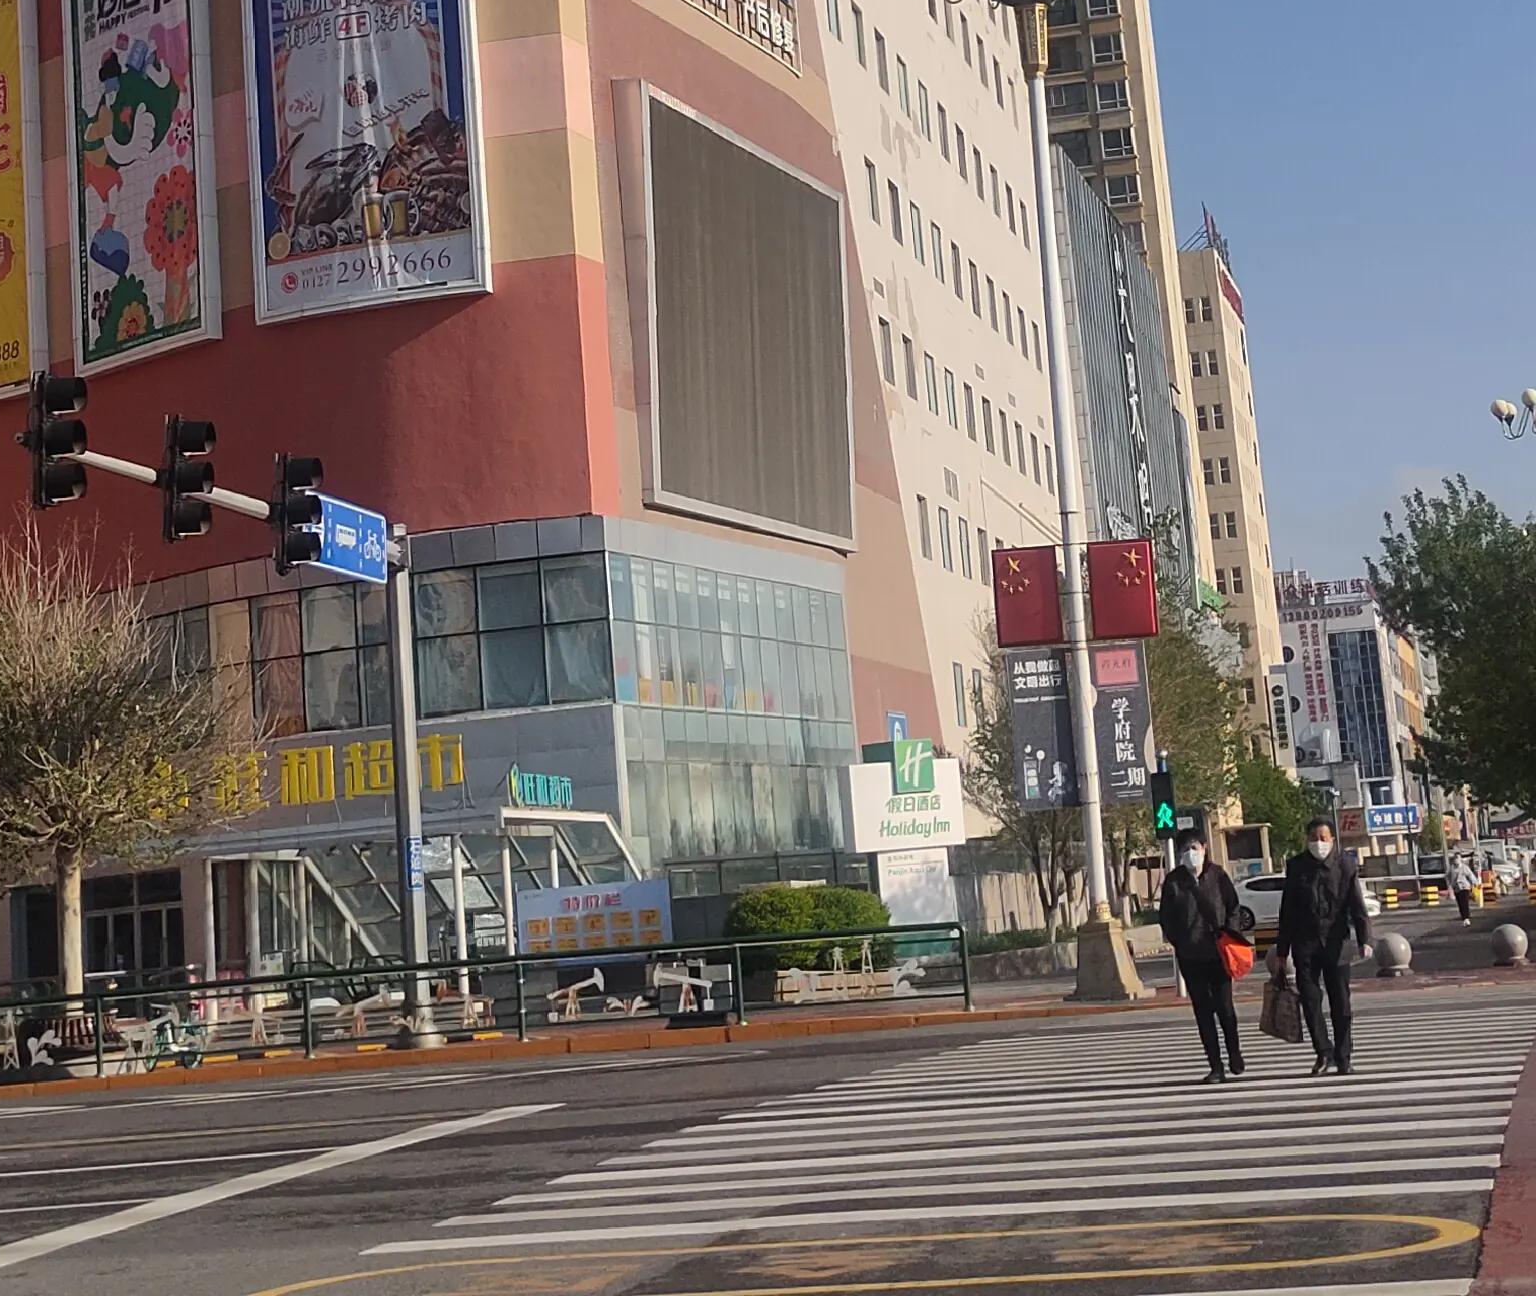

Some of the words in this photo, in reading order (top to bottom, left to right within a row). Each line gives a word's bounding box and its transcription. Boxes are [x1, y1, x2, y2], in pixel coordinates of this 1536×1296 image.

[99, 12, 127, 35] HAPPY
[338, 16, 368, 36] 4F
[336, 247, 452, 284] 2992666
[1013, 674, 1063, 690] 文明出行
[1111, 697, 1138, 762] 学府院
[1111, 766, 1146, 788] 二期
[885, 794, 941, 814] 假日酒店
[879, 817, 931, 838] Holiday
[933, 816, 950, 833] Inn
